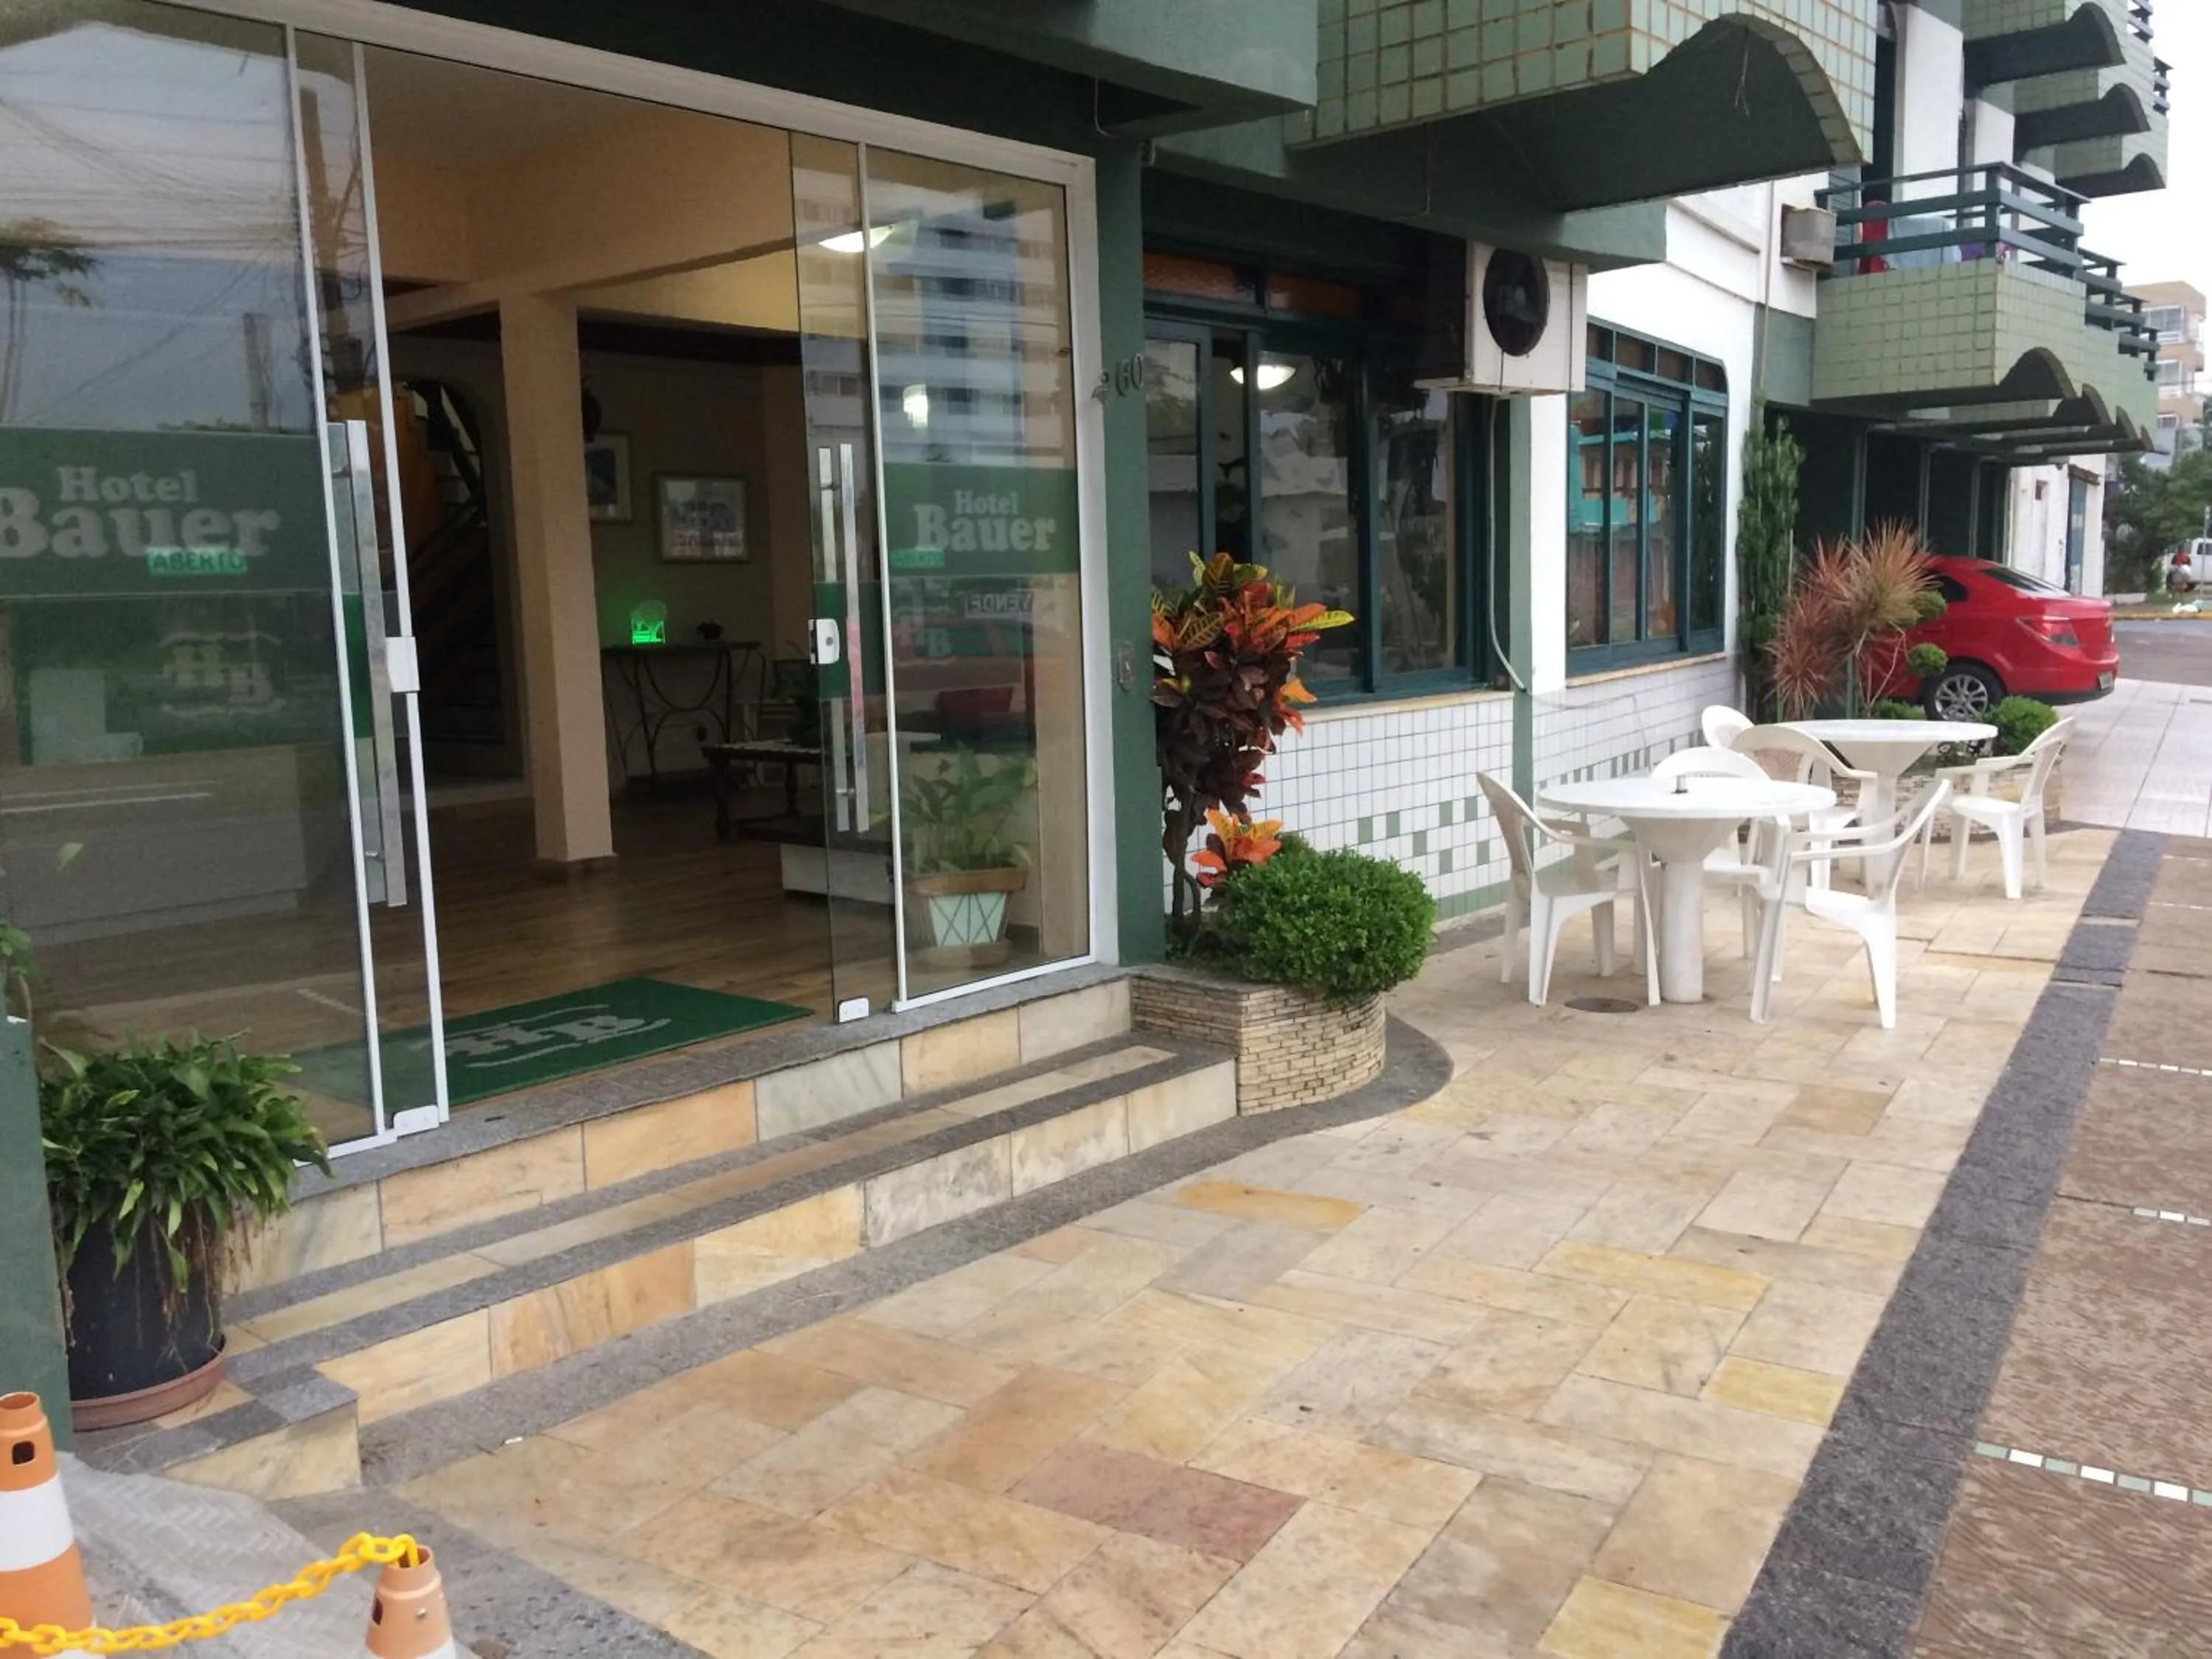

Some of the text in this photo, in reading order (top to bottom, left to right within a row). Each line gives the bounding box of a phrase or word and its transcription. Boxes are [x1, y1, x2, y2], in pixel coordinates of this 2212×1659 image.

[57, 465, 200, 503] Hotel
[954, 490, 1019, 515] Hotel
[0, 487, 281, 557] Bauer
[914, 503, 1057, 552] Bauer
[152, 551, 245, 571] ABERTO
